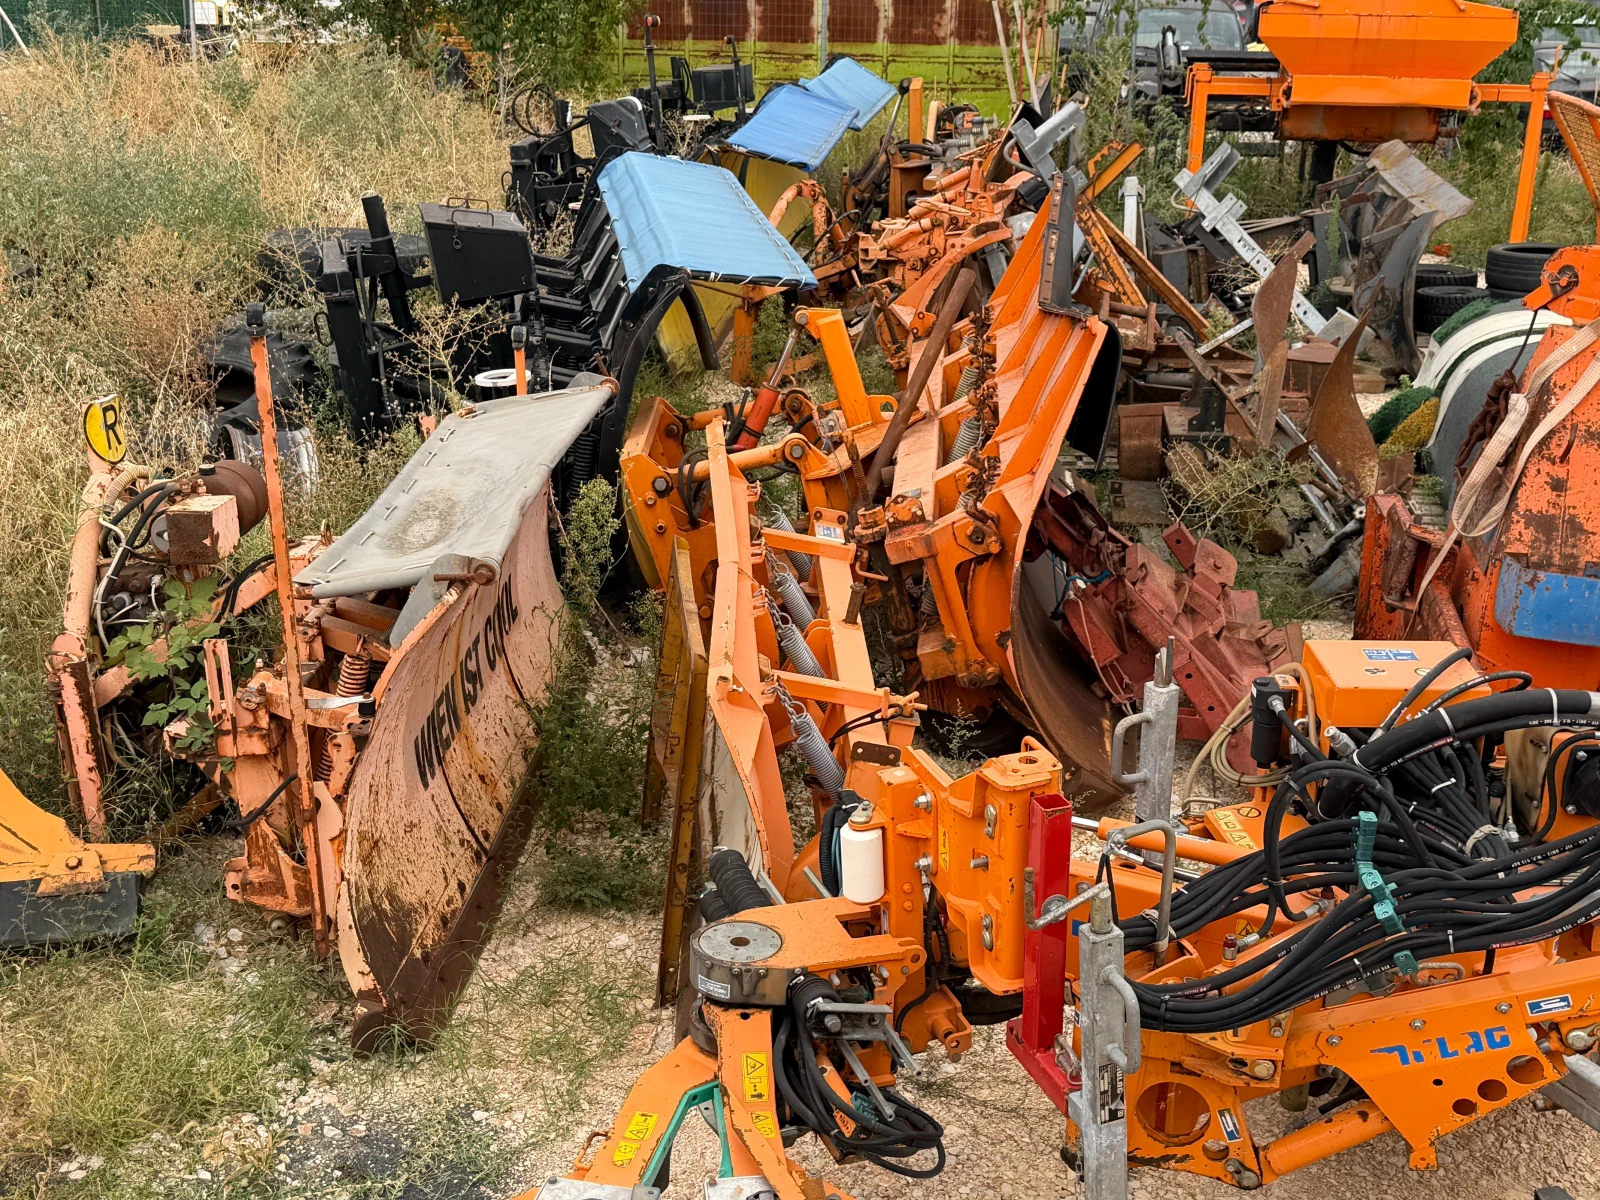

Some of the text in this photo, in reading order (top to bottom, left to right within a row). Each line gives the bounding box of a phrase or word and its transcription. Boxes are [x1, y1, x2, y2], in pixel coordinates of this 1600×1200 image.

[102, 404, 122, 450] R
[414, 572, 520, 792] WIEN IST COOL
